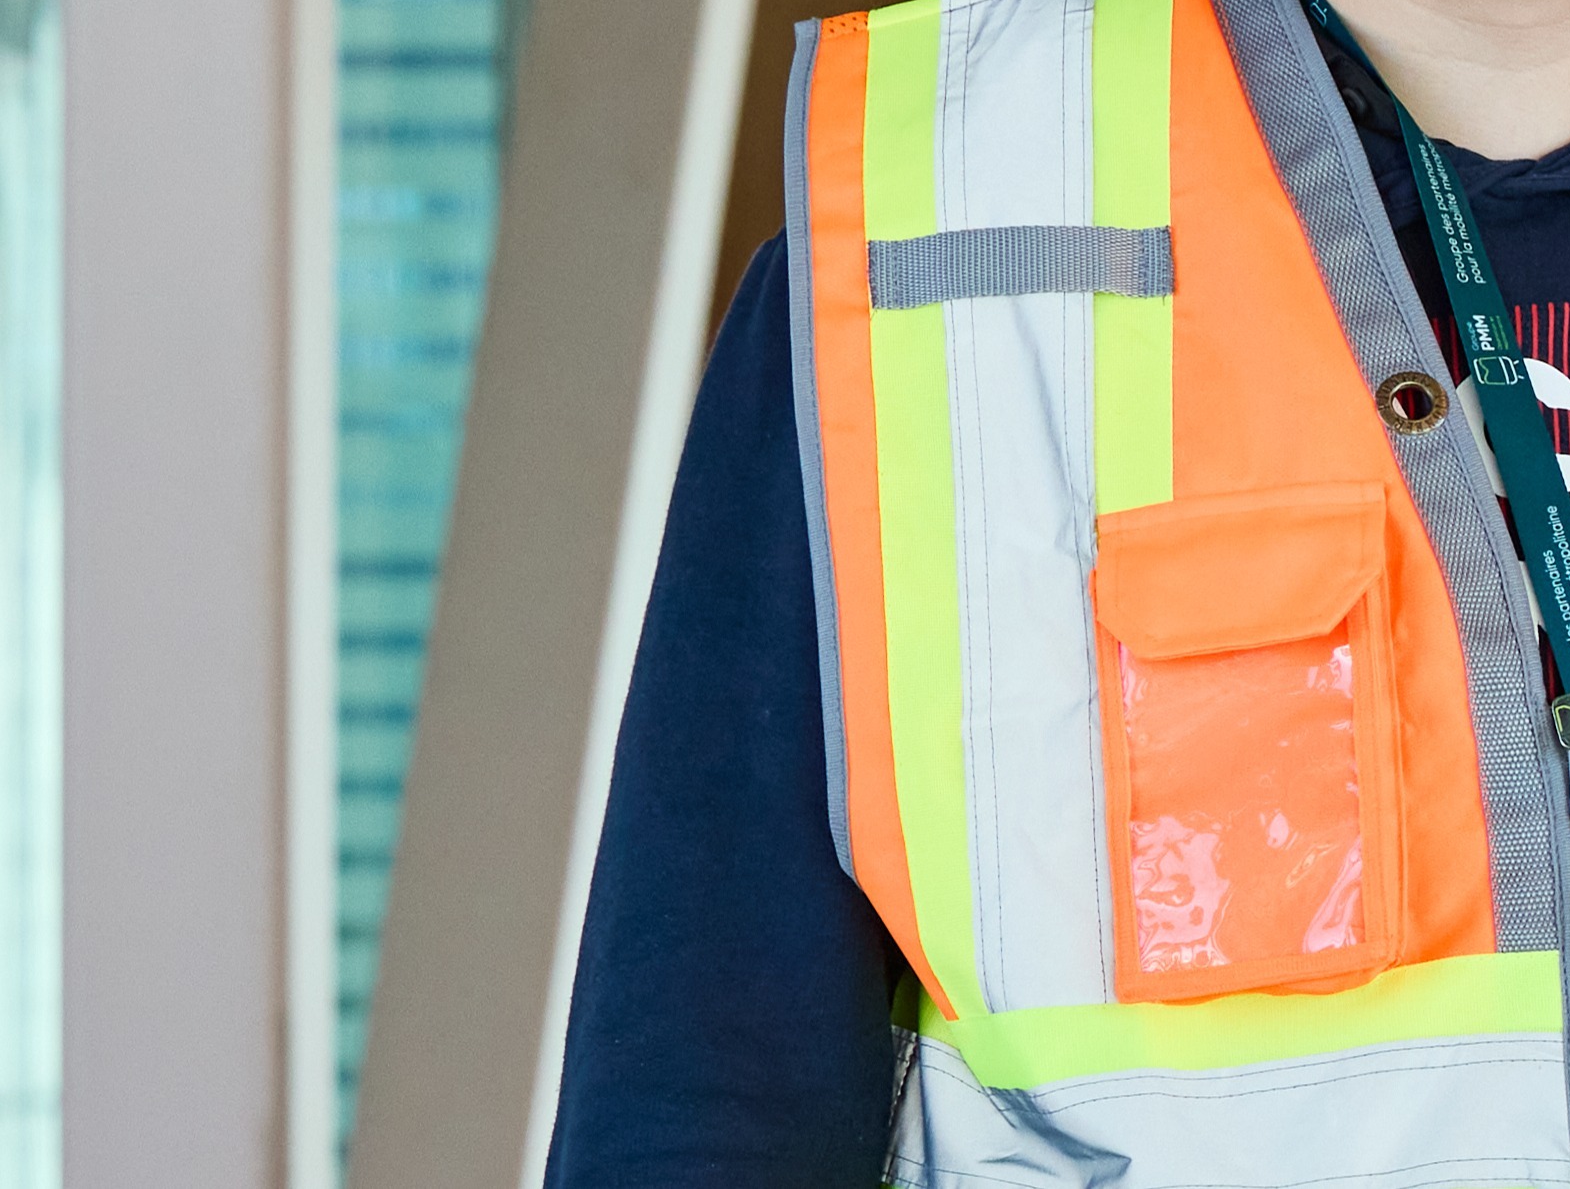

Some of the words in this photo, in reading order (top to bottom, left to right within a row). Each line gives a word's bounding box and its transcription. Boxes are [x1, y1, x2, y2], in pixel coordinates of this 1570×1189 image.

[1419, 143, 1448, 211] partenaires
[1441, 213, 1454, 236] des
[1445, 192, 1469, 240] mobilité
[1449, 237, 1469, 283] Groupe
[1463, 242, 1473, 254] la
[1467, 256, 1486, 284] pour
[1472, 315, 1495, 351] PMM
